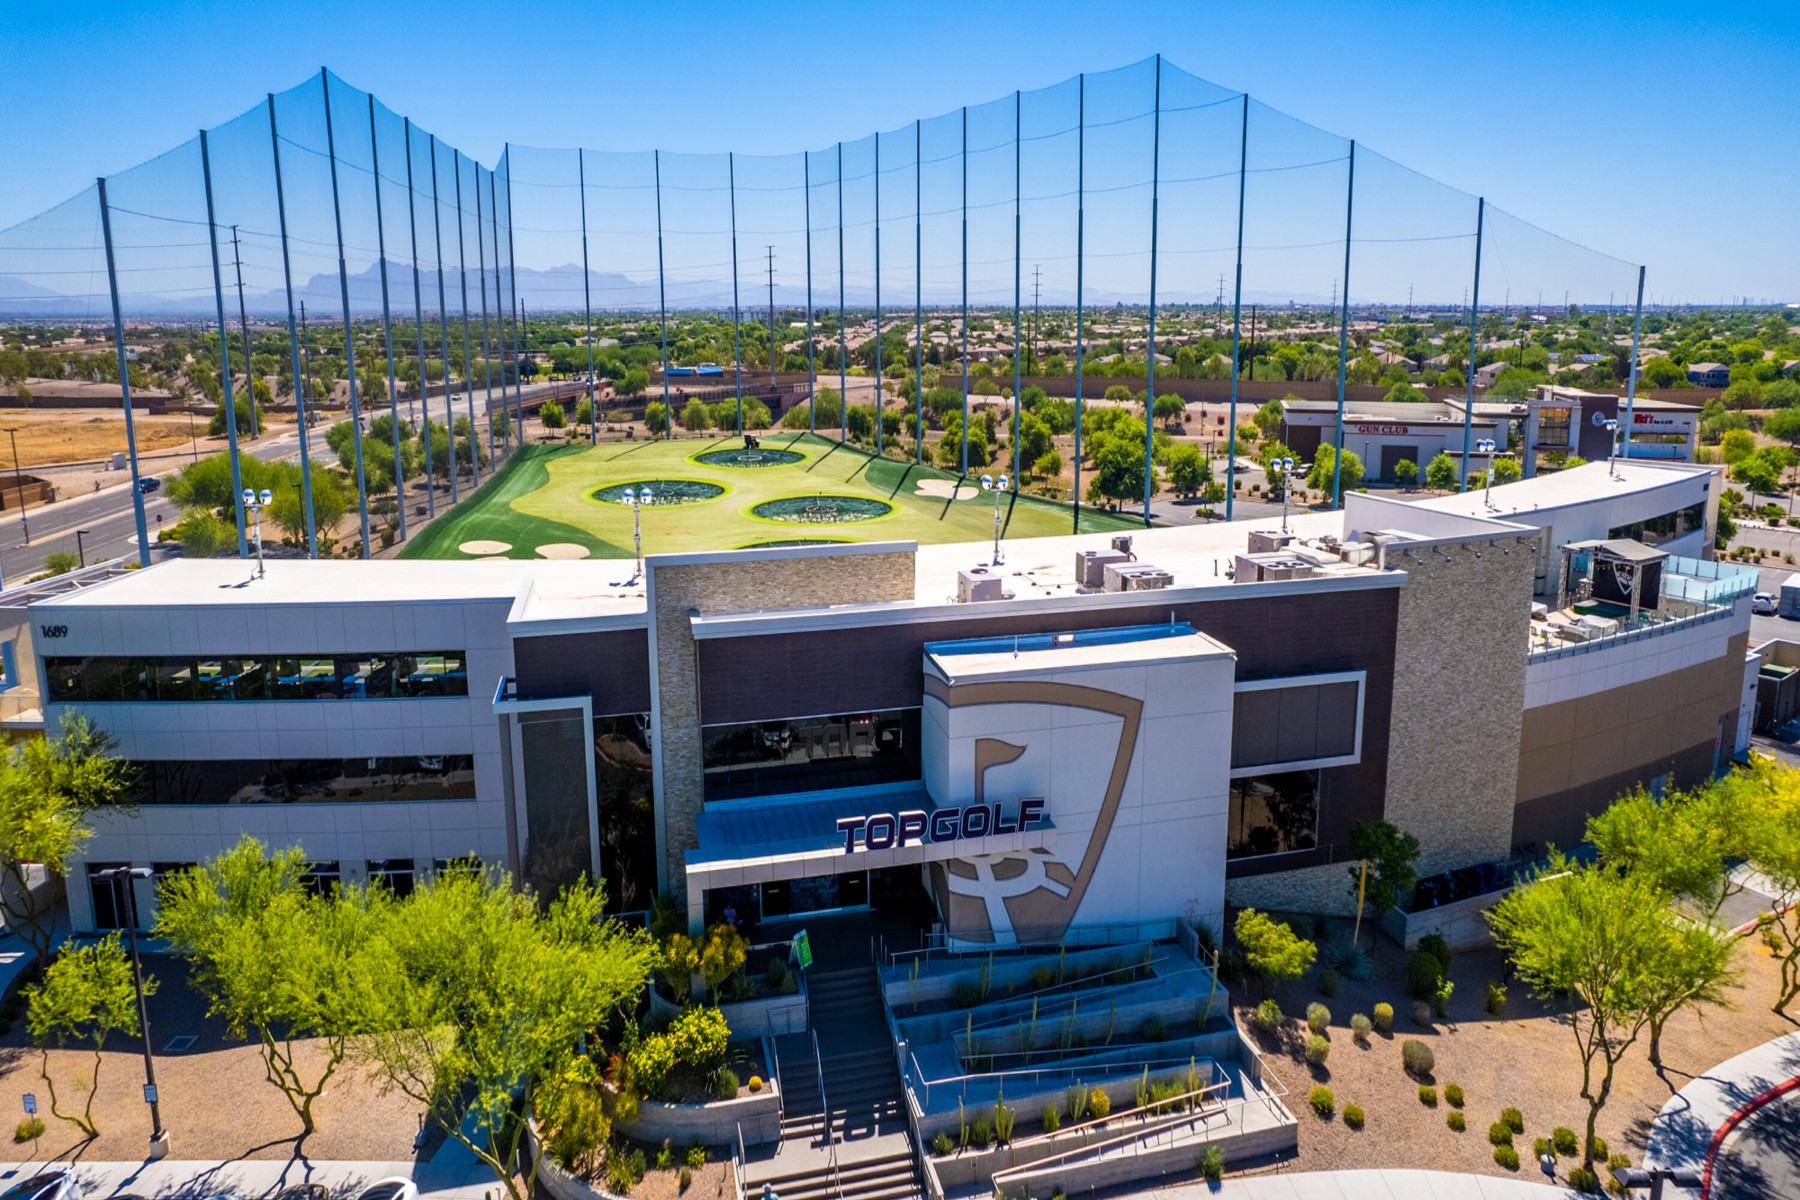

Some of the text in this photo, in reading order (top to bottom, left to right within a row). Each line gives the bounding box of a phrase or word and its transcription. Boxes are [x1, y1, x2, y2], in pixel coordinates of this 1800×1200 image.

[1359, 425, 1408, 434] GUN CLUB
[41, 625, 68, 638] 1689
[836, 797, 1045, 854] TOPGOLF
